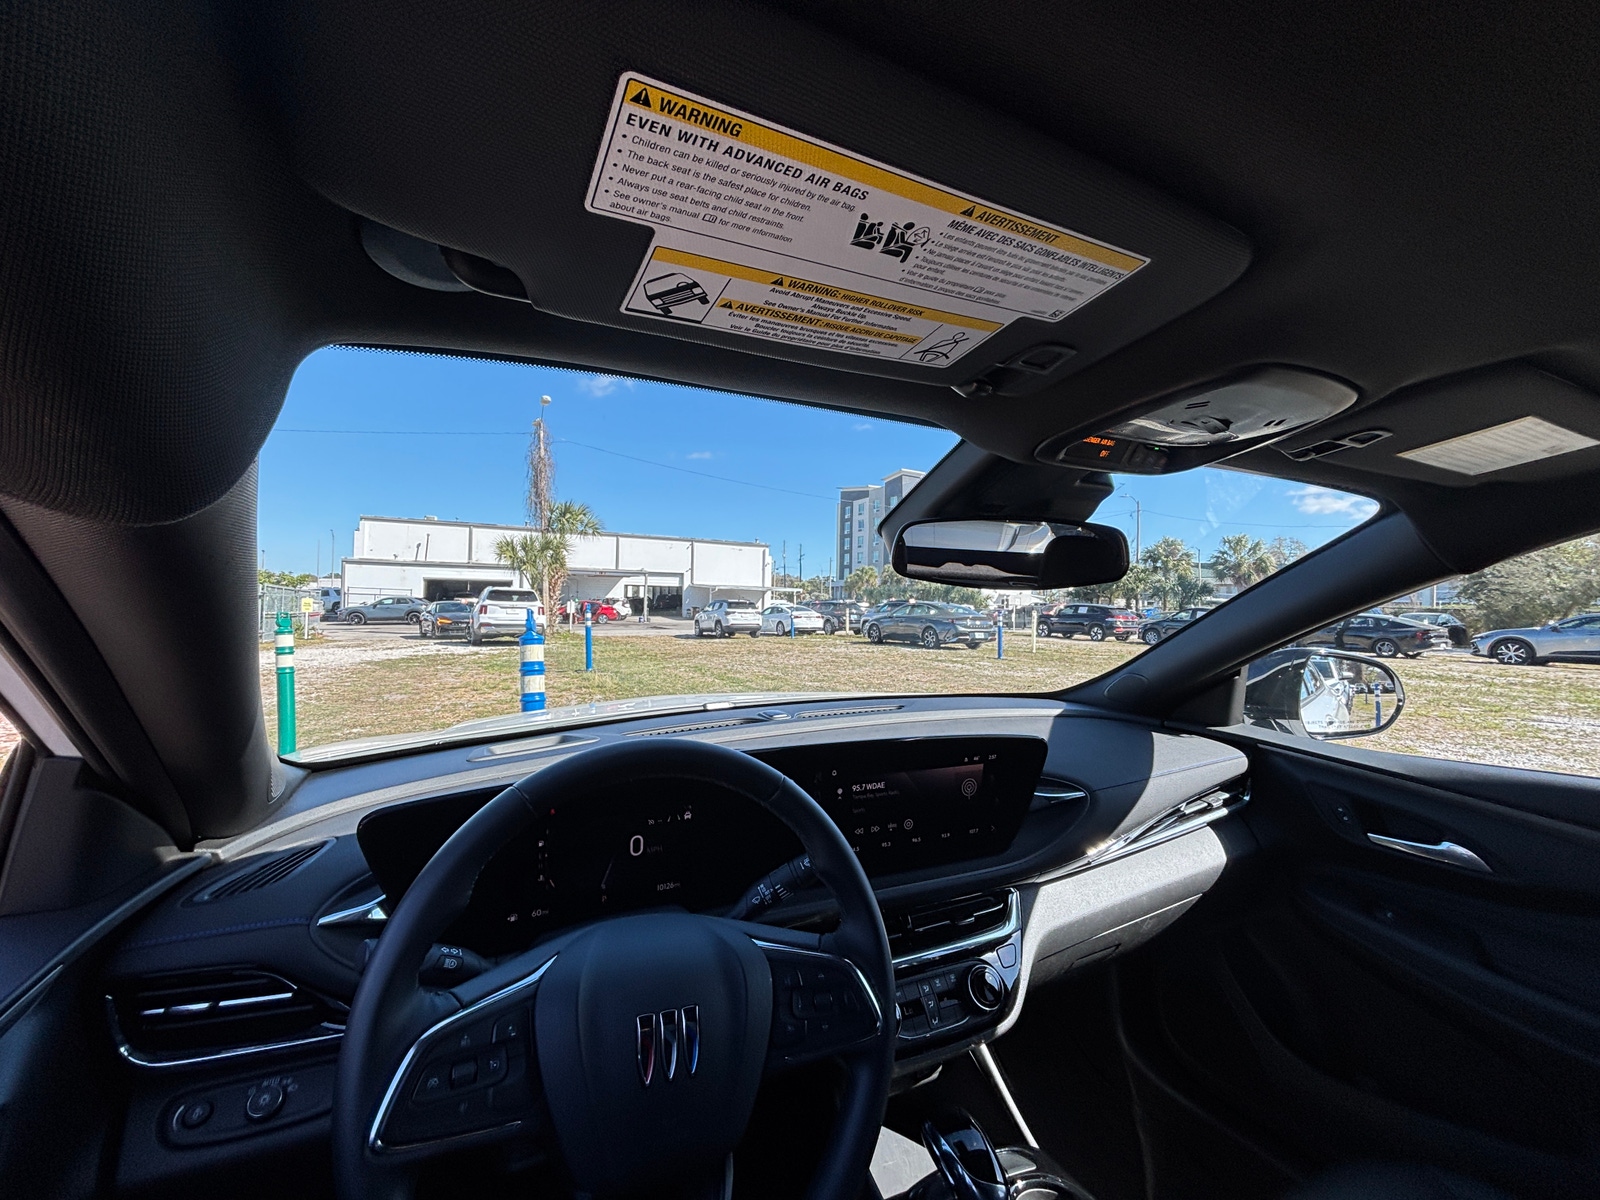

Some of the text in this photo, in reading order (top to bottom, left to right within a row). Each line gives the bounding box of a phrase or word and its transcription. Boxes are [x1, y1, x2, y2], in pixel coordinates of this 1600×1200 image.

[659, 96, 742, 137] WARNING
[625, 112, 869, 200] EVEN WITH ADVANCED AIR BAGS
[627, 149, 644, 161] The
[646, 155, 669, 169] back
[671, 164, 691, 175] seat
[692, 169, 700, 178] is
[702, 172, 716, 183] the
[717, 178, 744, 191] safest
[743, 186, 766, 197] place
[767, 192, 779, 201] for
[631, 135, 671, 154] Children
[672, 149, 690, 160] can
[691, 153, 703, 164] be
[704, 158, 730, 171] killed
[740, 170, 778, 188] seriously
[777, 182, 807, 195] injured
[805, 190, 816, 199] by
[816, 193, 829, 203] the
[609, 201, 635, 213] about
[616, 177, 649, 192] Always
[651, 188, 667, 197] use
[669, 192, 688, 202] seat
[689, 197, 710, 208] belts
[711, 204, 728, 213] and
[727, 209, 748, 218] child
[621, 163, 649, 177] Never
[650, 173, 666, 183] put
[675, 180, 722, 199] rear-facing
[723, 194, 744, 204] child
[743, 200, 762, 210] seat
[771, 207, 784, 216] the
[613, 189, 792, 242] See owner's manual for more information
[976, 211, 1060, 243] AVERTISSEMENT
[947, 219, 977, 234] MÊME
[973, 228, 999, 241] AVEC
[995, 235, 1016, 246] DES
[1012, 240, 1037, 252] SACS
[1033, 247, 1081, 266] GONFLABLES
[1077, 261, 1124, 280] INTELLIGENTS
[769, 287, 791, 296] Avoid
[789, 291, 814, 301] Abrupt
[814, 297, 850, 308] Maneuvers
[862, 307, 892, 317] Excessive
[787, 279, 925, 316] WARNING: HIGHER ROLLOVER RISK
[822, 322, 851, 331] RISQUE
[849, 327, 875, 335] ACCRU
[851, 781, 886, 792] 95.7 WDAE
[629, 834, 645, 857] 0
